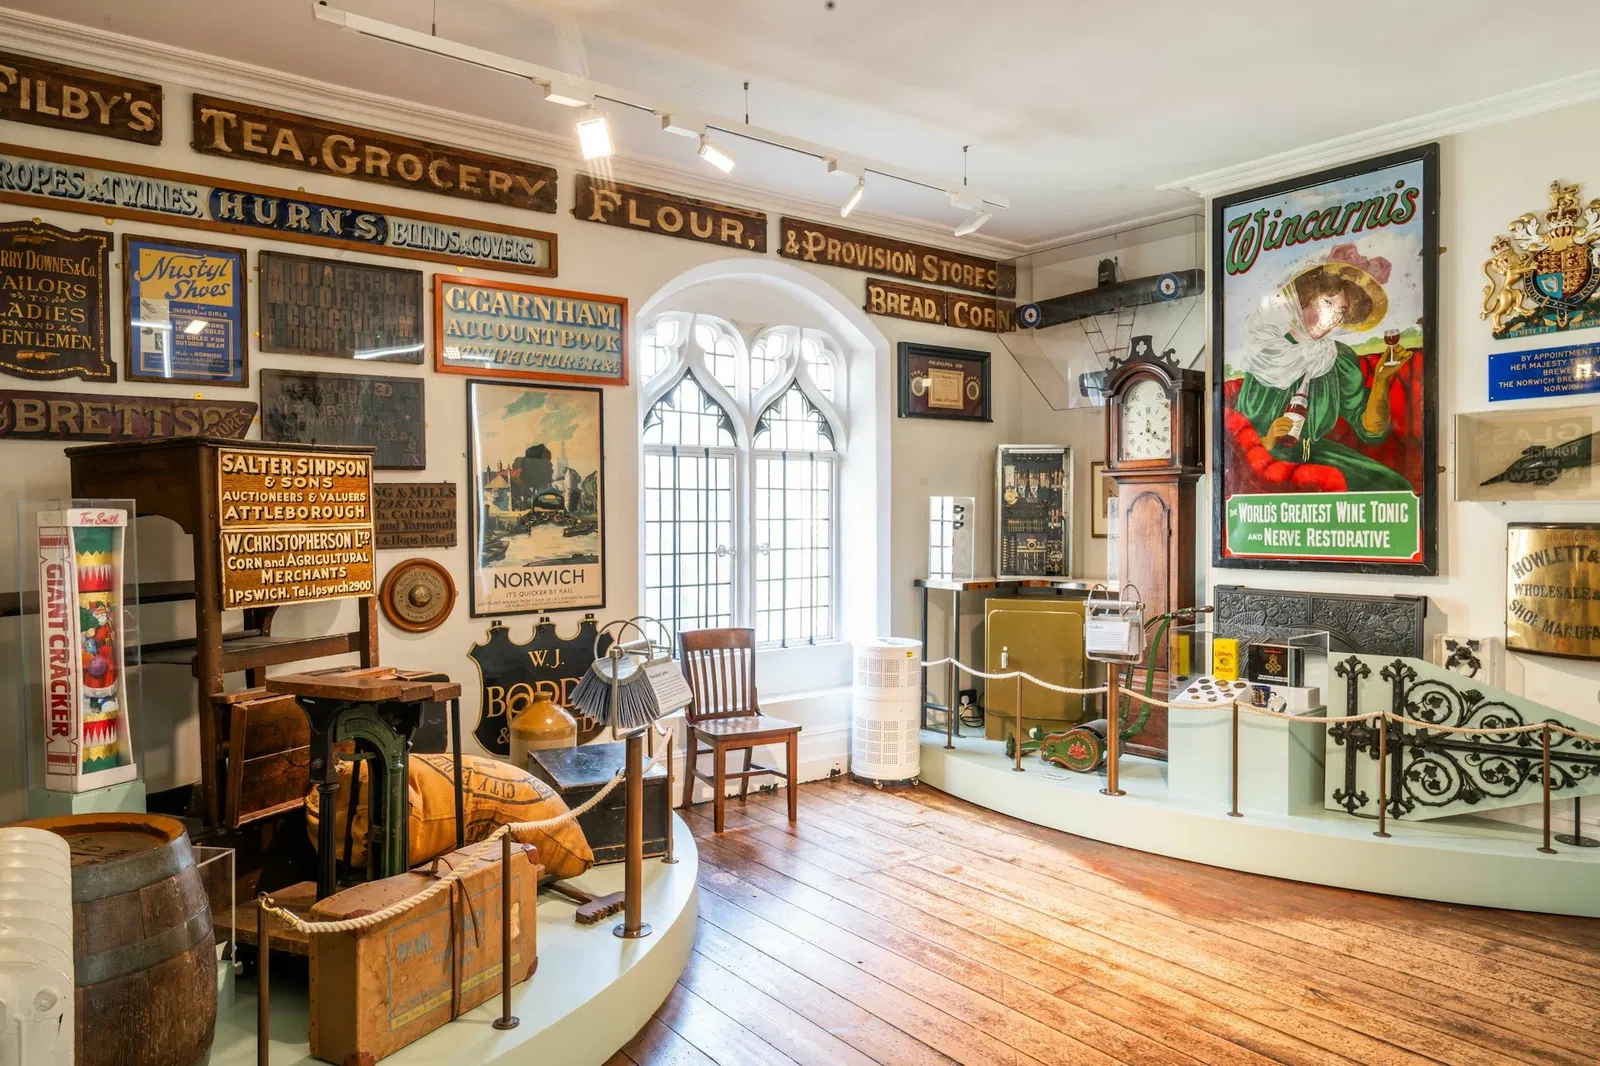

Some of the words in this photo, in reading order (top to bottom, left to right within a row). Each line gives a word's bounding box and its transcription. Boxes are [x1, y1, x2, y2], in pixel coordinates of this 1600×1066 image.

[321, 134, 546, 200] GROCERY
[589, 186, 755, 249] FLOUR,
[1226, 179, 1420, 275] Wincarnis
[134, 254, 235, 283] Nustyl
[785, 229, 800, 254] &
[803, 230, 917, 275] PROVISION
[922, 254, 997, 290] STORES
[0, 274, 87, 303] AILORS
[30, 294, 49, 303] TO
[164, 279, 231, 300] Shoes
[25, 321, 55, 331] AND
[446, 318, 555, 347] ACCOUNT
[560, 329, 622, 353] BOOK
[1529, 359, 1567, 370] MAJESTY
[1534, 348, 1593, 361] APPOINTMENT
[1516, 377, 1555, 386] NORWICH
[11, 398, 201, 437] BRETTS
[297, 458, 368, 477] SIMPSON
[265, 476, 276, 488] &
[281, 477, 334, 488] SONS
[223, 491, 303, 503] AUCTIONEERS
[308, 492, 318, 503] &
[320, 492, 366, 502] VALUERS
[80, 512, 94, 525] Tom
[94, 512, 120, 526] Smith
[224, 505, 366, 520] ATTLEBOROUGH
[1238, 502, 1278, 524] WORLD'S
[1280, 502, 1332, 524] GREATEST
[1336, 501, 1366, 524] WINE
[1370, 500, 1409, 524] TONIC
[1264, 528, 1302, 548] NERVE
[1306, 528, 1391, 548] RESTORATIVE
[228, 556, 263, 571] CORN
[264, 556, 286, 569] and
[286, 552, 370, 568] AGRICULTURAL
[1512, 545, 1588, 579] HOWLETT
[261, 566, 348, 585] MERCHANTS
[494, 569, 584, 589] NORWICH
[45, 562, 65, 631] GIANT
[312, 580, 349, 598] Ipswich
[349, 580, 372, 592] 2900
[519, 589, 548, 598] QUICKER
[1514, 583, 1591, 600] WHOLESALE
[1509, 599, 1540, 628] SHOE
[48, 639, 72, 738] CRACKER
[487, 677, 583, 721] BODD
[478, 778, 516, 800] CITY
